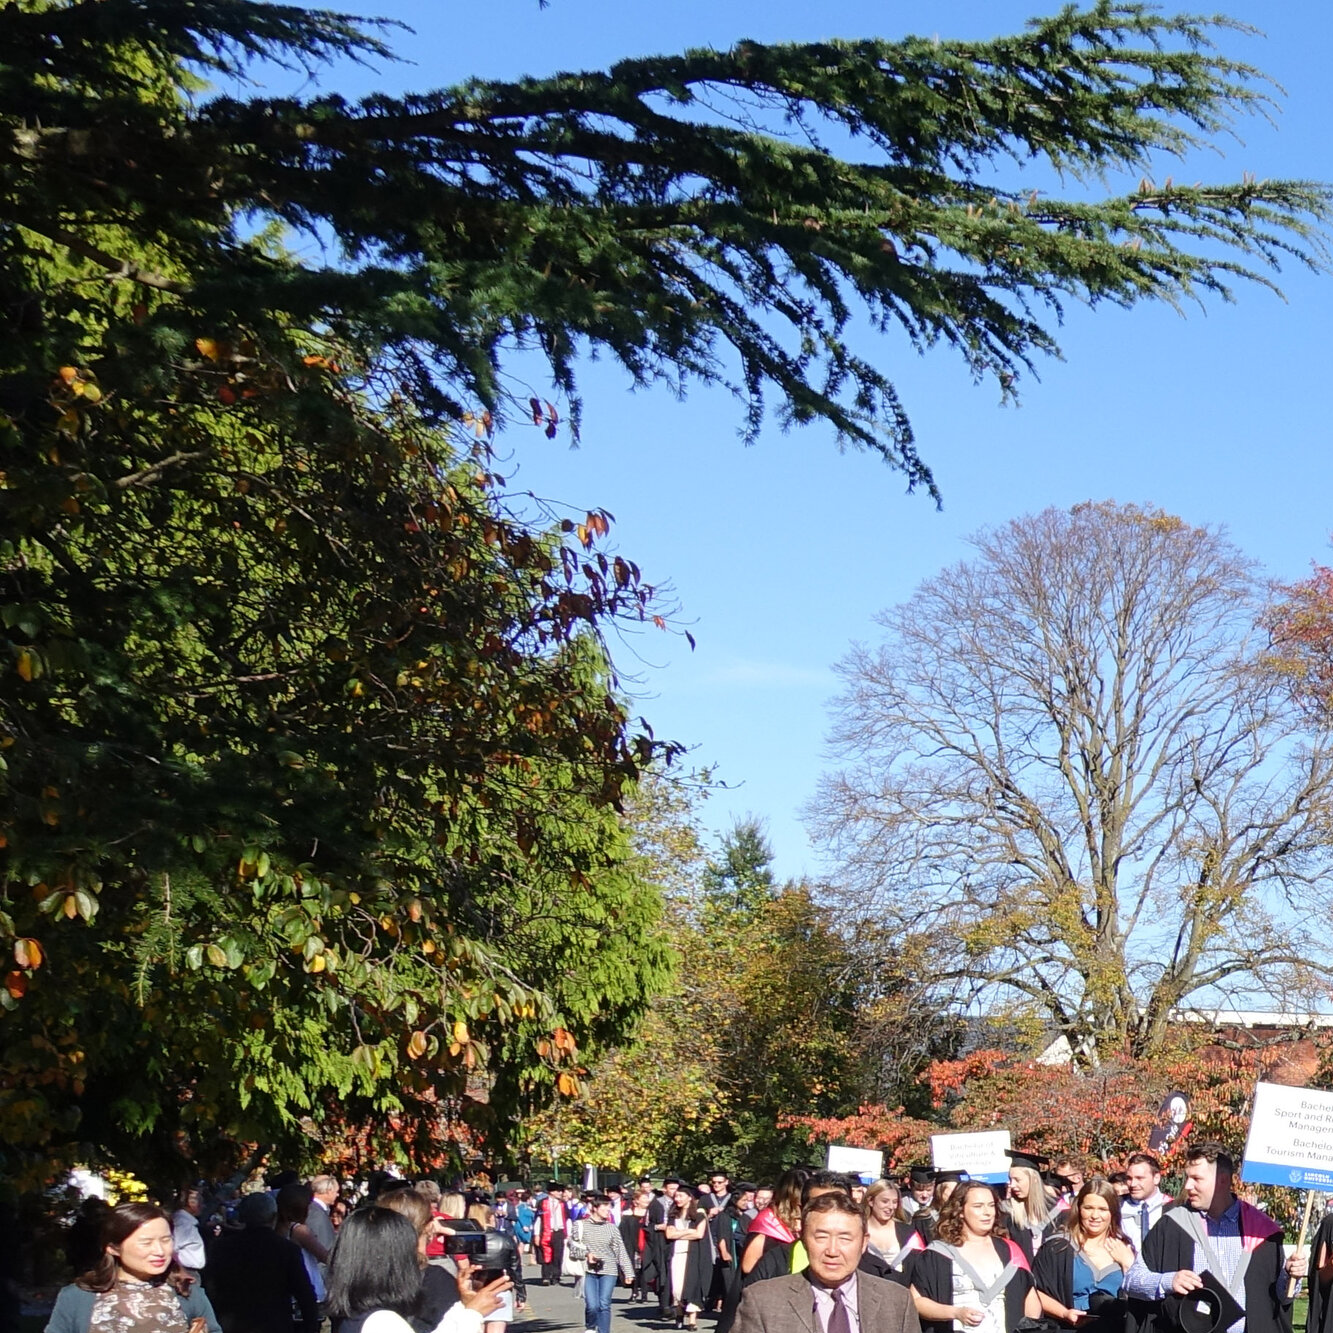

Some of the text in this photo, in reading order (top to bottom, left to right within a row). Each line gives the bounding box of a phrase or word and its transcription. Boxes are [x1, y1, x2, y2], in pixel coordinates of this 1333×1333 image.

[1274, 1108, 1302, 1121] Sport
[1304, 1112, 1323, 1122] and
[1266, 1146, 1305, 1159] Tourism
